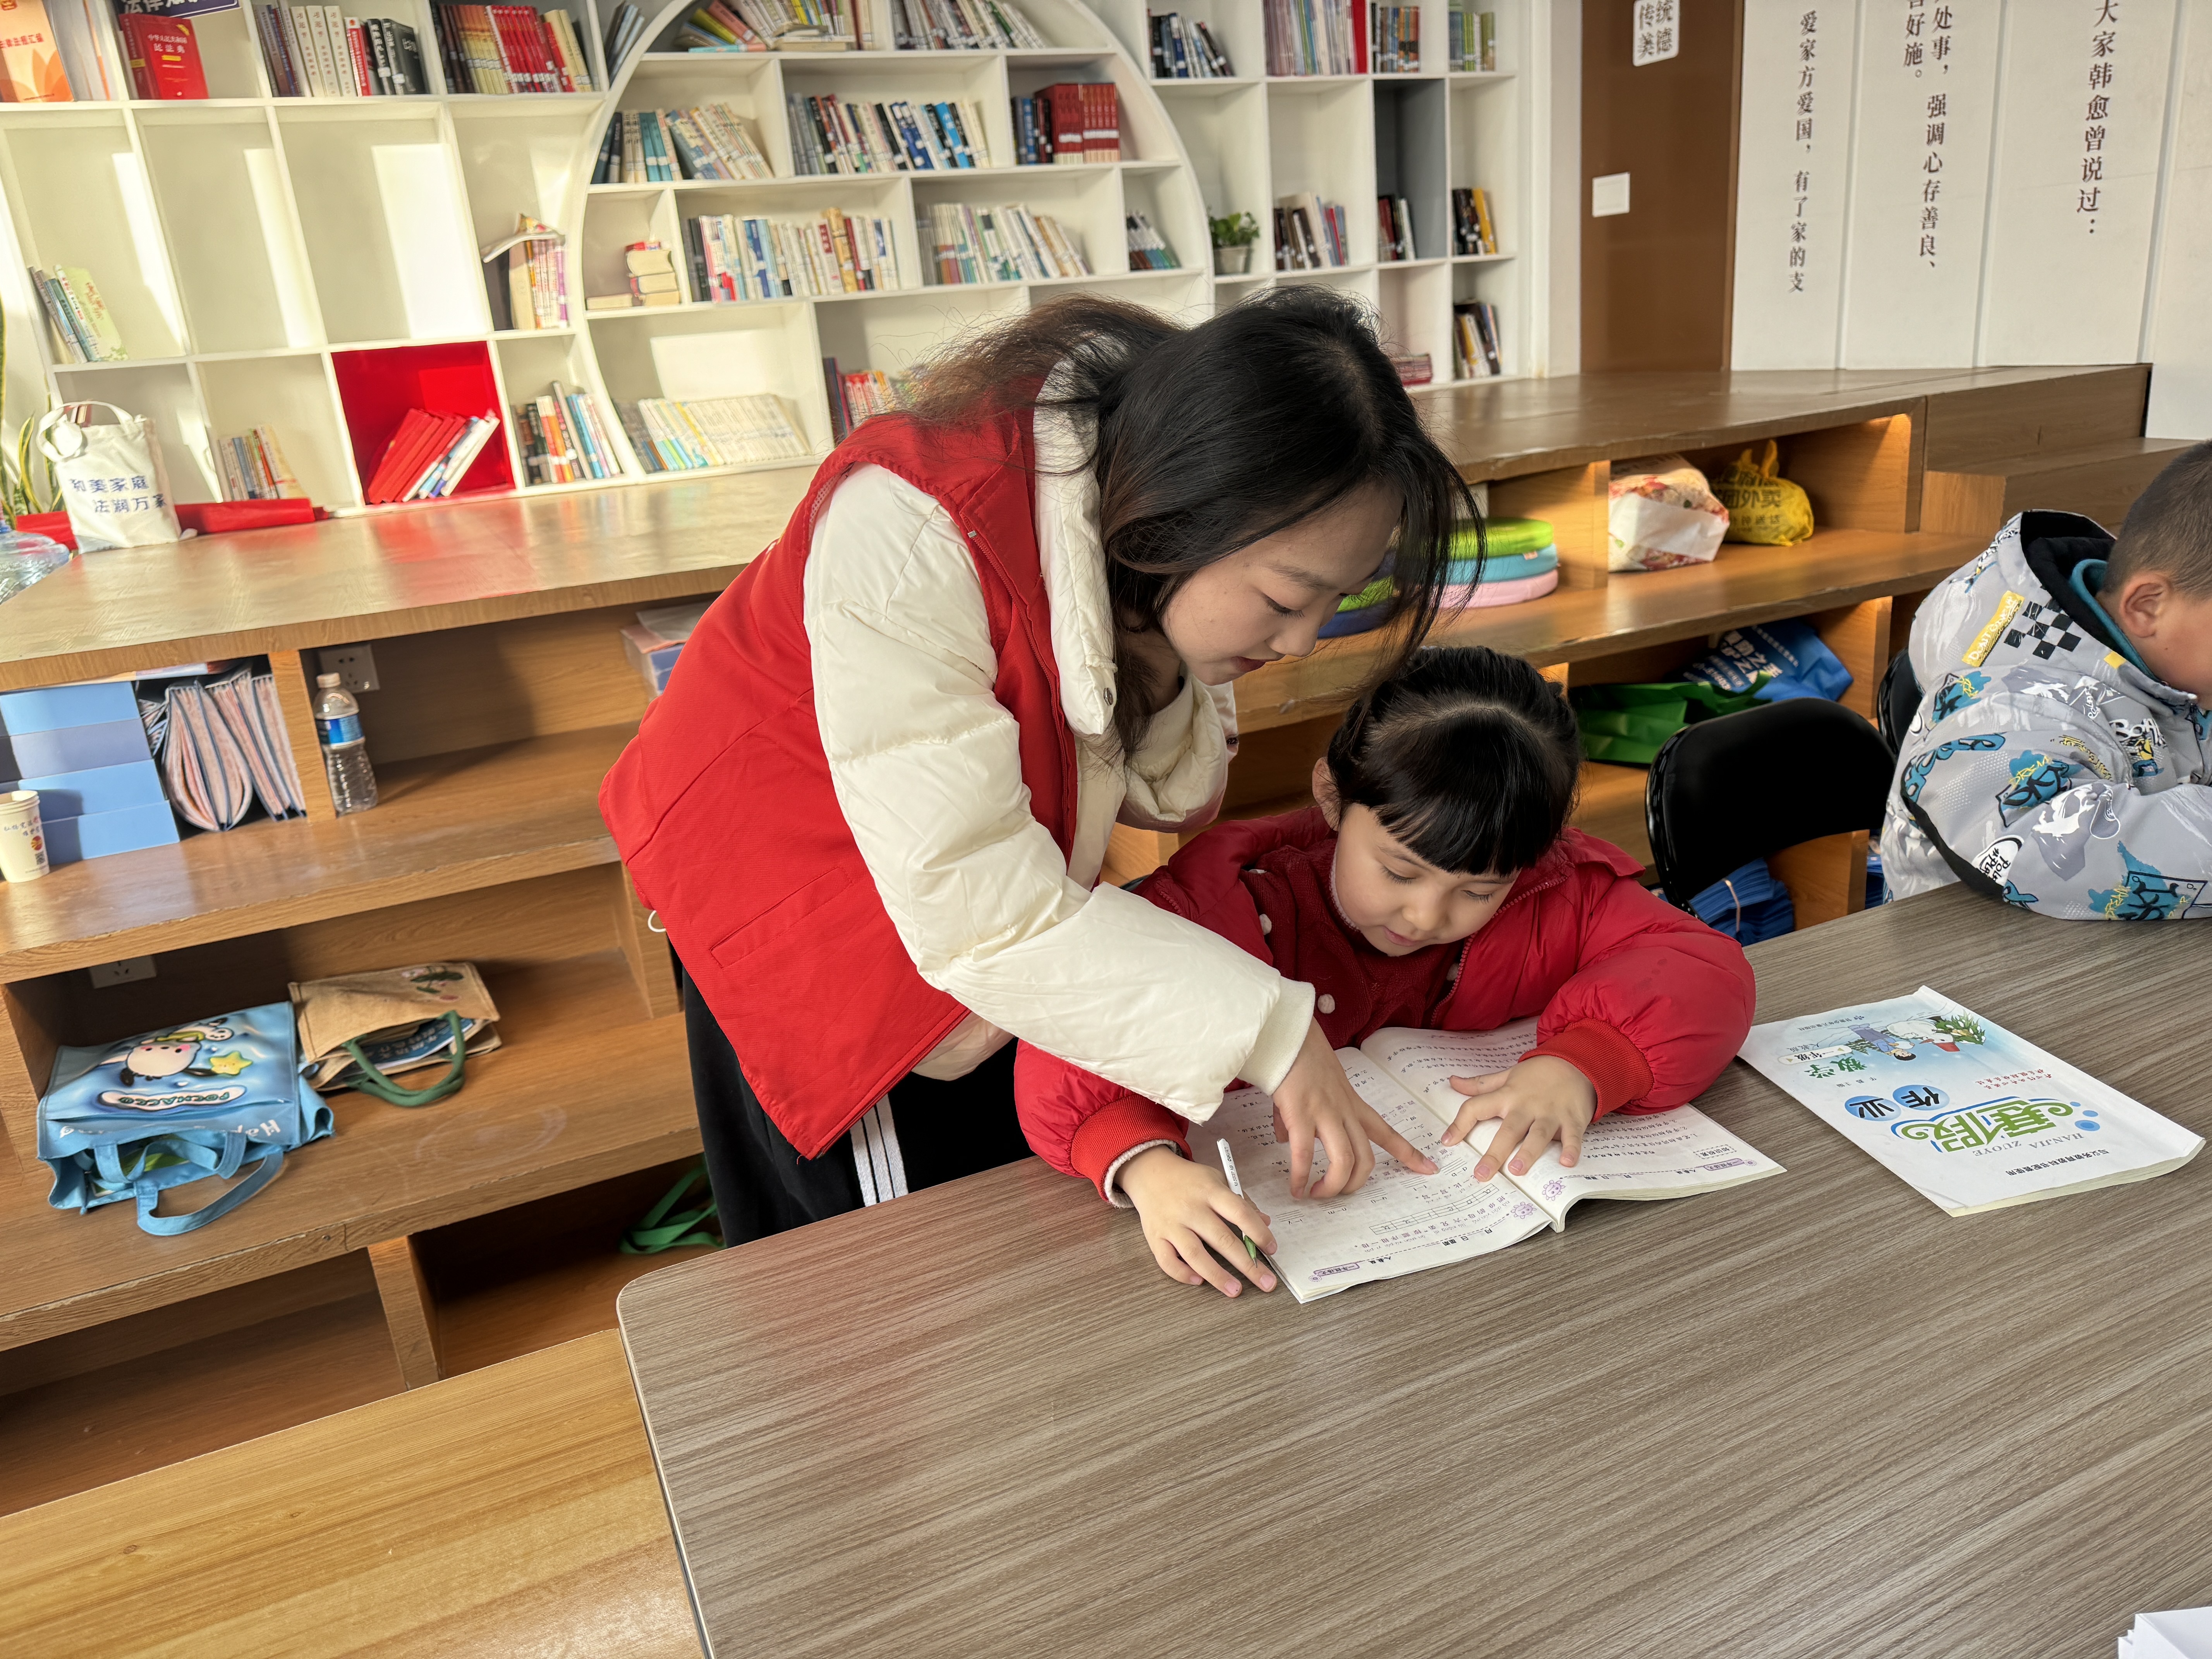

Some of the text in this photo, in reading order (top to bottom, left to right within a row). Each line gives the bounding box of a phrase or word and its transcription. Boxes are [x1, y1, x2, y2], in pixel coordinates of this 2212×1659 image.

[1920, 0, 1953, 268] 处事，强调心存善良、
[1787, 1042, 1819, 1053] 人教版
[1794, 1051, 1834, 1062] 一年级
[1804, 1056, 1867, 1079] 数学
[1849, 1087, 1939, 1119] 作业
[1901, 1100, 2073, 1153] 寒假
[1972, 1133, 2084, 1156] HANJIA ZUOYE
[2005, 1149, 2109, 1176] 与义务教育教科书配套使用
